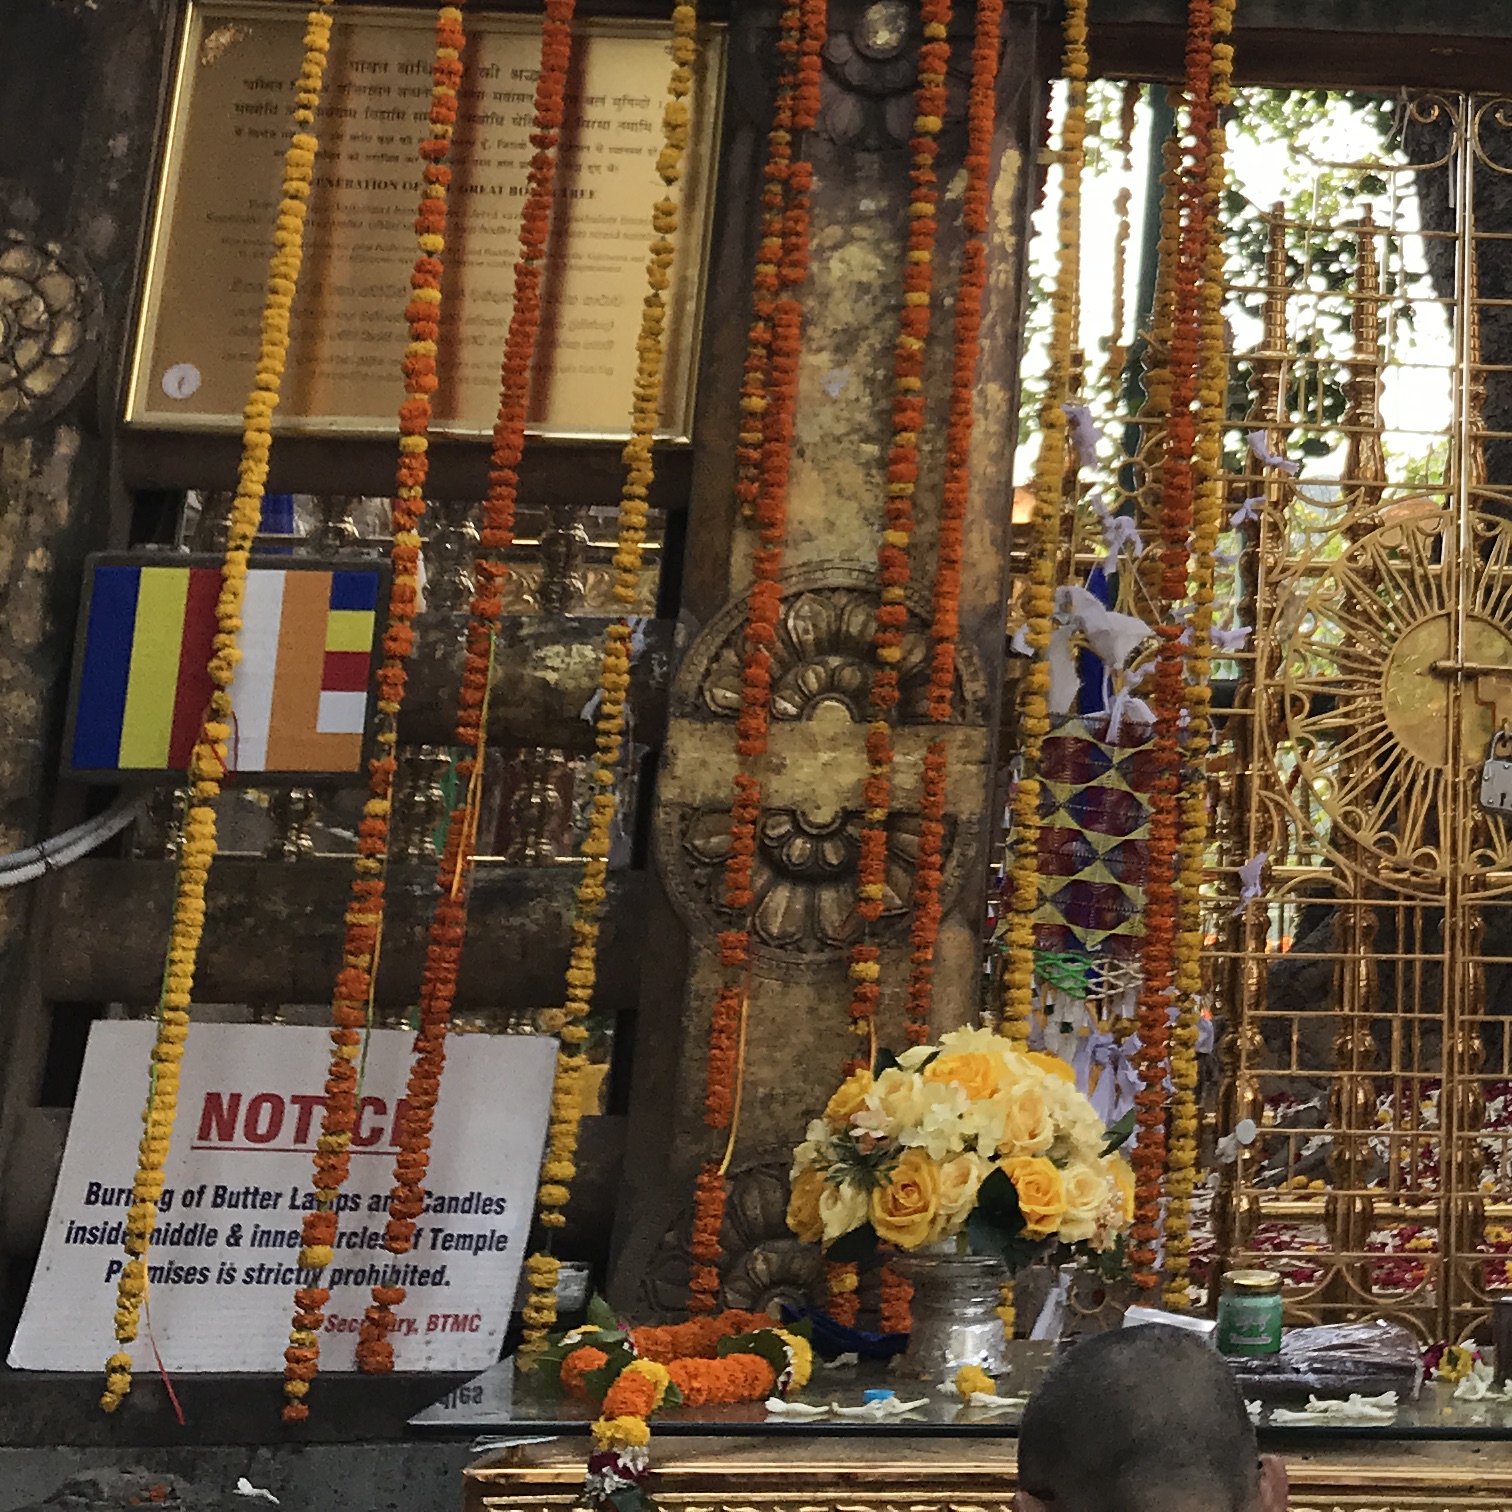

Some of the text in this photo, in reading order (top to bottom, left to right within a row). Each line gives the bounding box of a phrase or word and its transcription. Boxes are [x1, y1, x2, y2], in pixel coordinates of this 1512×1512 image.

[197, 1091, 412, 1147] NOTC
[84, 1182, 174, 1212] Burng
[182, 1185, 207, 1208] of
[212, 1185, 283, 1210] Butter
[288, 1187, 361, 1214] Laps
[367, 1192, 395, 1213] an
[225, 1223, 244, 1248] &
[250, 1224, 303, 1248] inne
[428, 1227, 509, 1256] Temple
[105, 1260, 211, 1285] Pmises
[216, 1261, 238, 1285] is
[426, 1313, 483, 1334] BTMC
